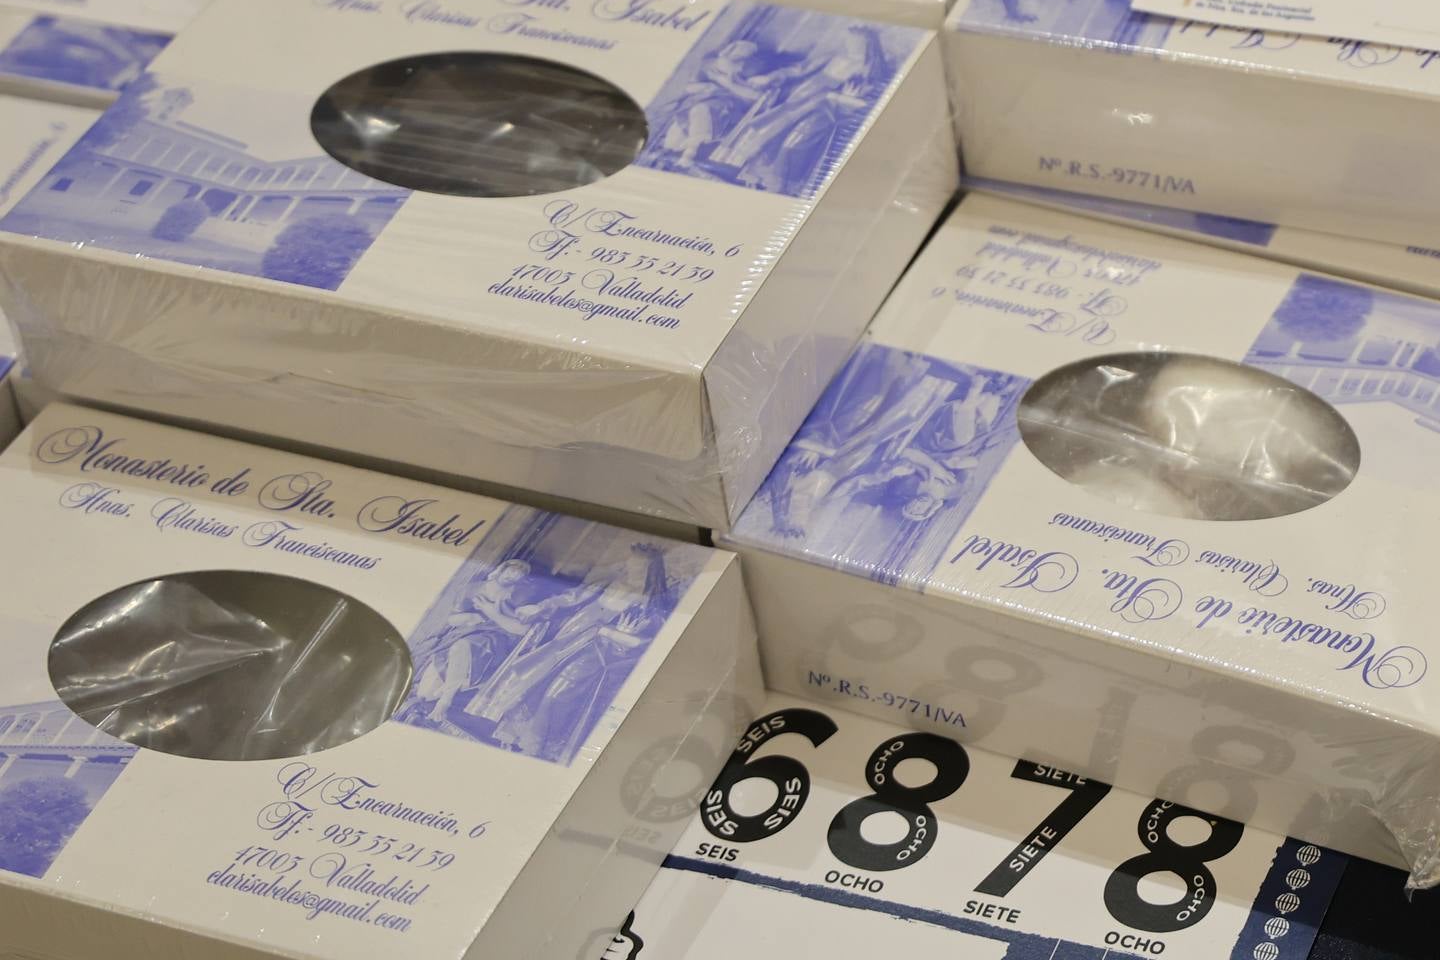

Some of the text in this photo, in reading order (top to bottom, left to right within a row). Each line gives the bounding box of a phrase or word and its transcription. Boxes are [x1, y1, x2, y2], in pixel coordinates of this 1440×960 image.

[724, 243, 745, 258] 6
[581, 268, 694, 310] Valladolid
[36, 425, 485, 547] Monasterio de Sta. Isabel
[59, 482, 382, 570] Hnas. Clarisas Franciscanas
[1047, 511, 1386, 620] Hnas. Clarisas Franciscanas
[948, 533, 1428, 690] Monasterio de Sta. Isabel
[736, 715, 786, 753] SEIS
[874, 740, 904, 785] OCHO
[706, 789, 739, 837] SEIS
[763, 777, 801, 830] SEIS
[468, 820, 492, 839] 6
[695, 842, 740, 862] SEIS
[896, 814, 927, 861] OCHO
[1009, 826, 1057, 873] SIETE
[205, 862, 412, 933] clarisabelos@gmail.com
[309, 851, 430, 907] Valladolid
[824, 869, 884, 893] OCHO
[1175, 874, 1205, 922] OCHO
[962, 899, 1021, 924] SIETE
[1103, 931, 1166, 955] OCHO
